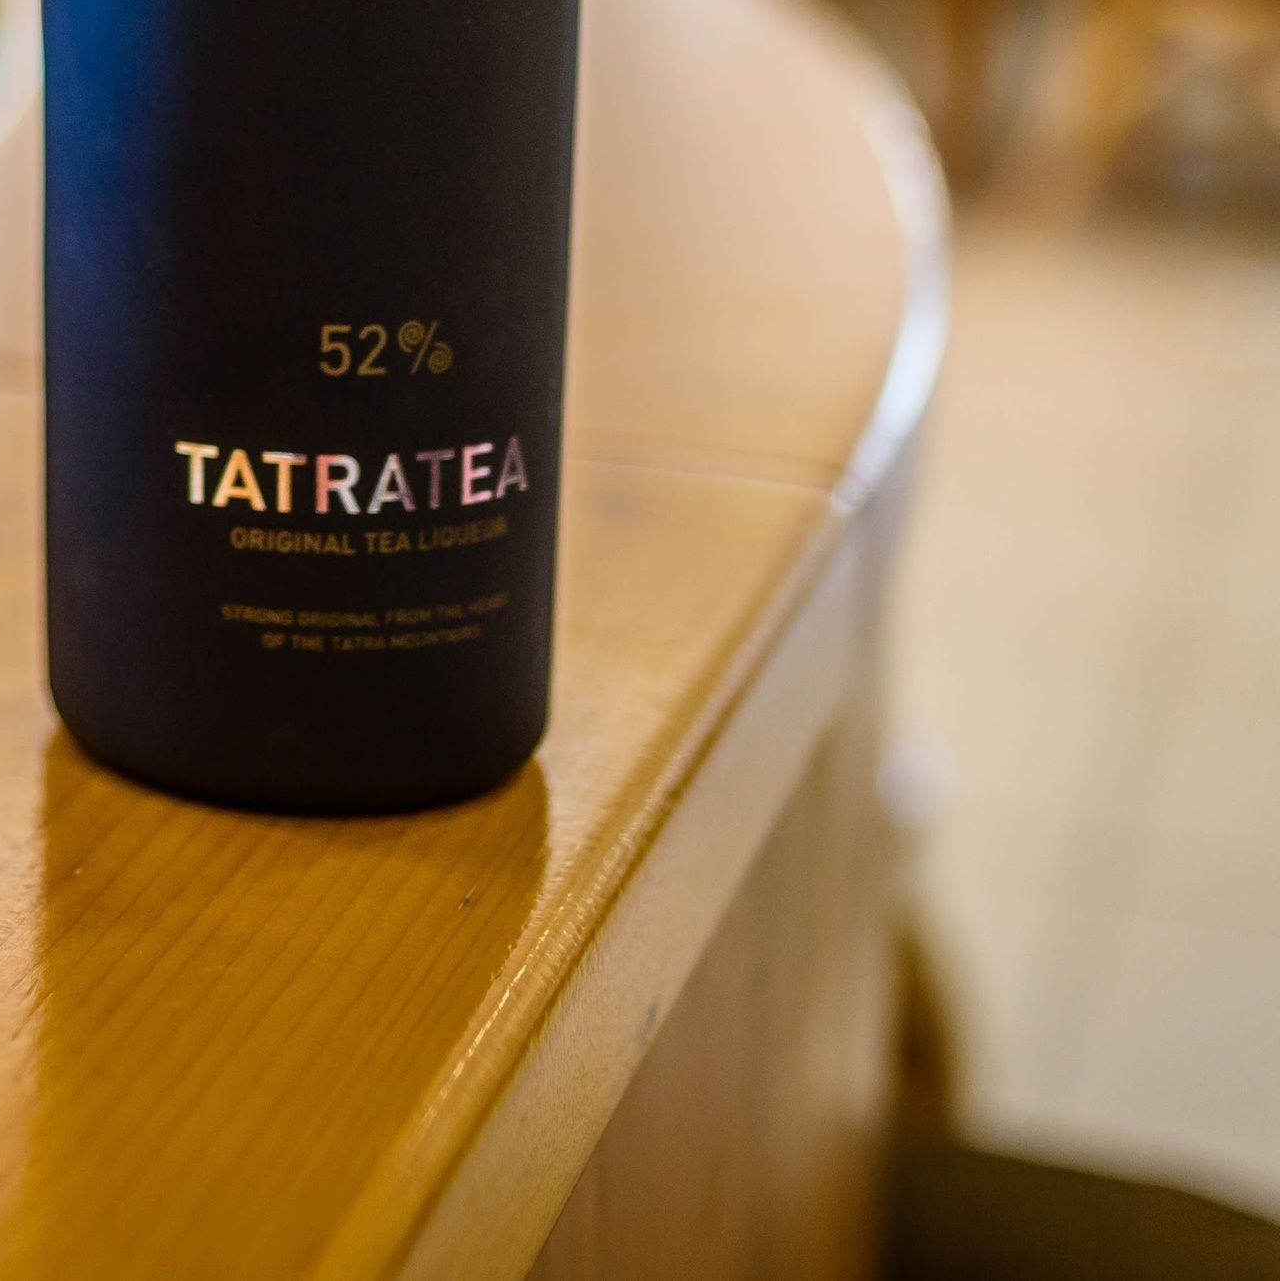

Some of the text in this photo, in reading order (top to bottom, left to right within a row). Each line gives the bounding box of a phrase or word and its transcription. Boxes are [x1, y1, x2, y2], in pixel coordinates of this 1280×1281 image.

[319, 320, 454, 376] 52%
[175, 435, 528, 514] TATRATEA
[230, 527, 356, 555] ORIGINAL
[365, 531, 411, 554] TEA
